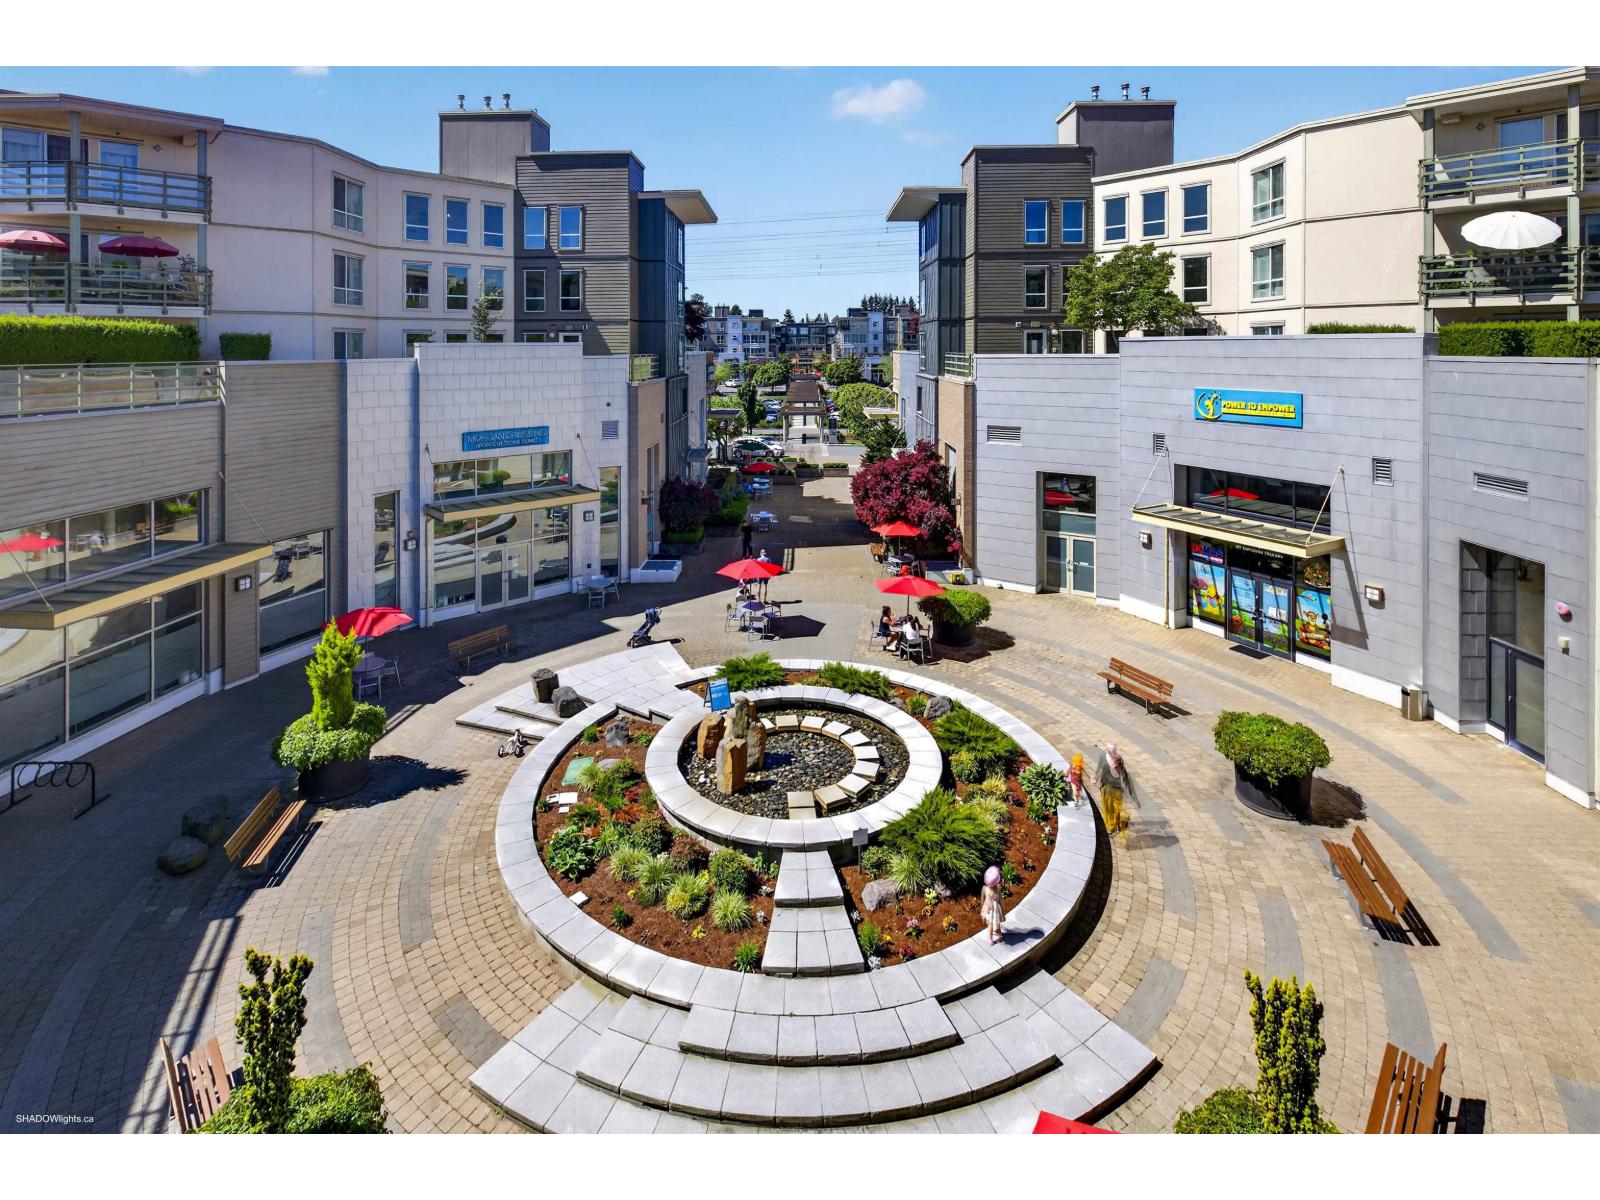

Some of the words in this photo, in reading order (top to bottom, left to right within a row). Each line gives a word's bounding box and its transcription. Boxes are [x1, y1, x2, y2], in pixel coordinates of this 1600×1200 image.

[1222, 400, 1246, 410] POWER
[1248, 402, 1257, 411] TO
[1258, 404, 1296, 413] EMPOWER
